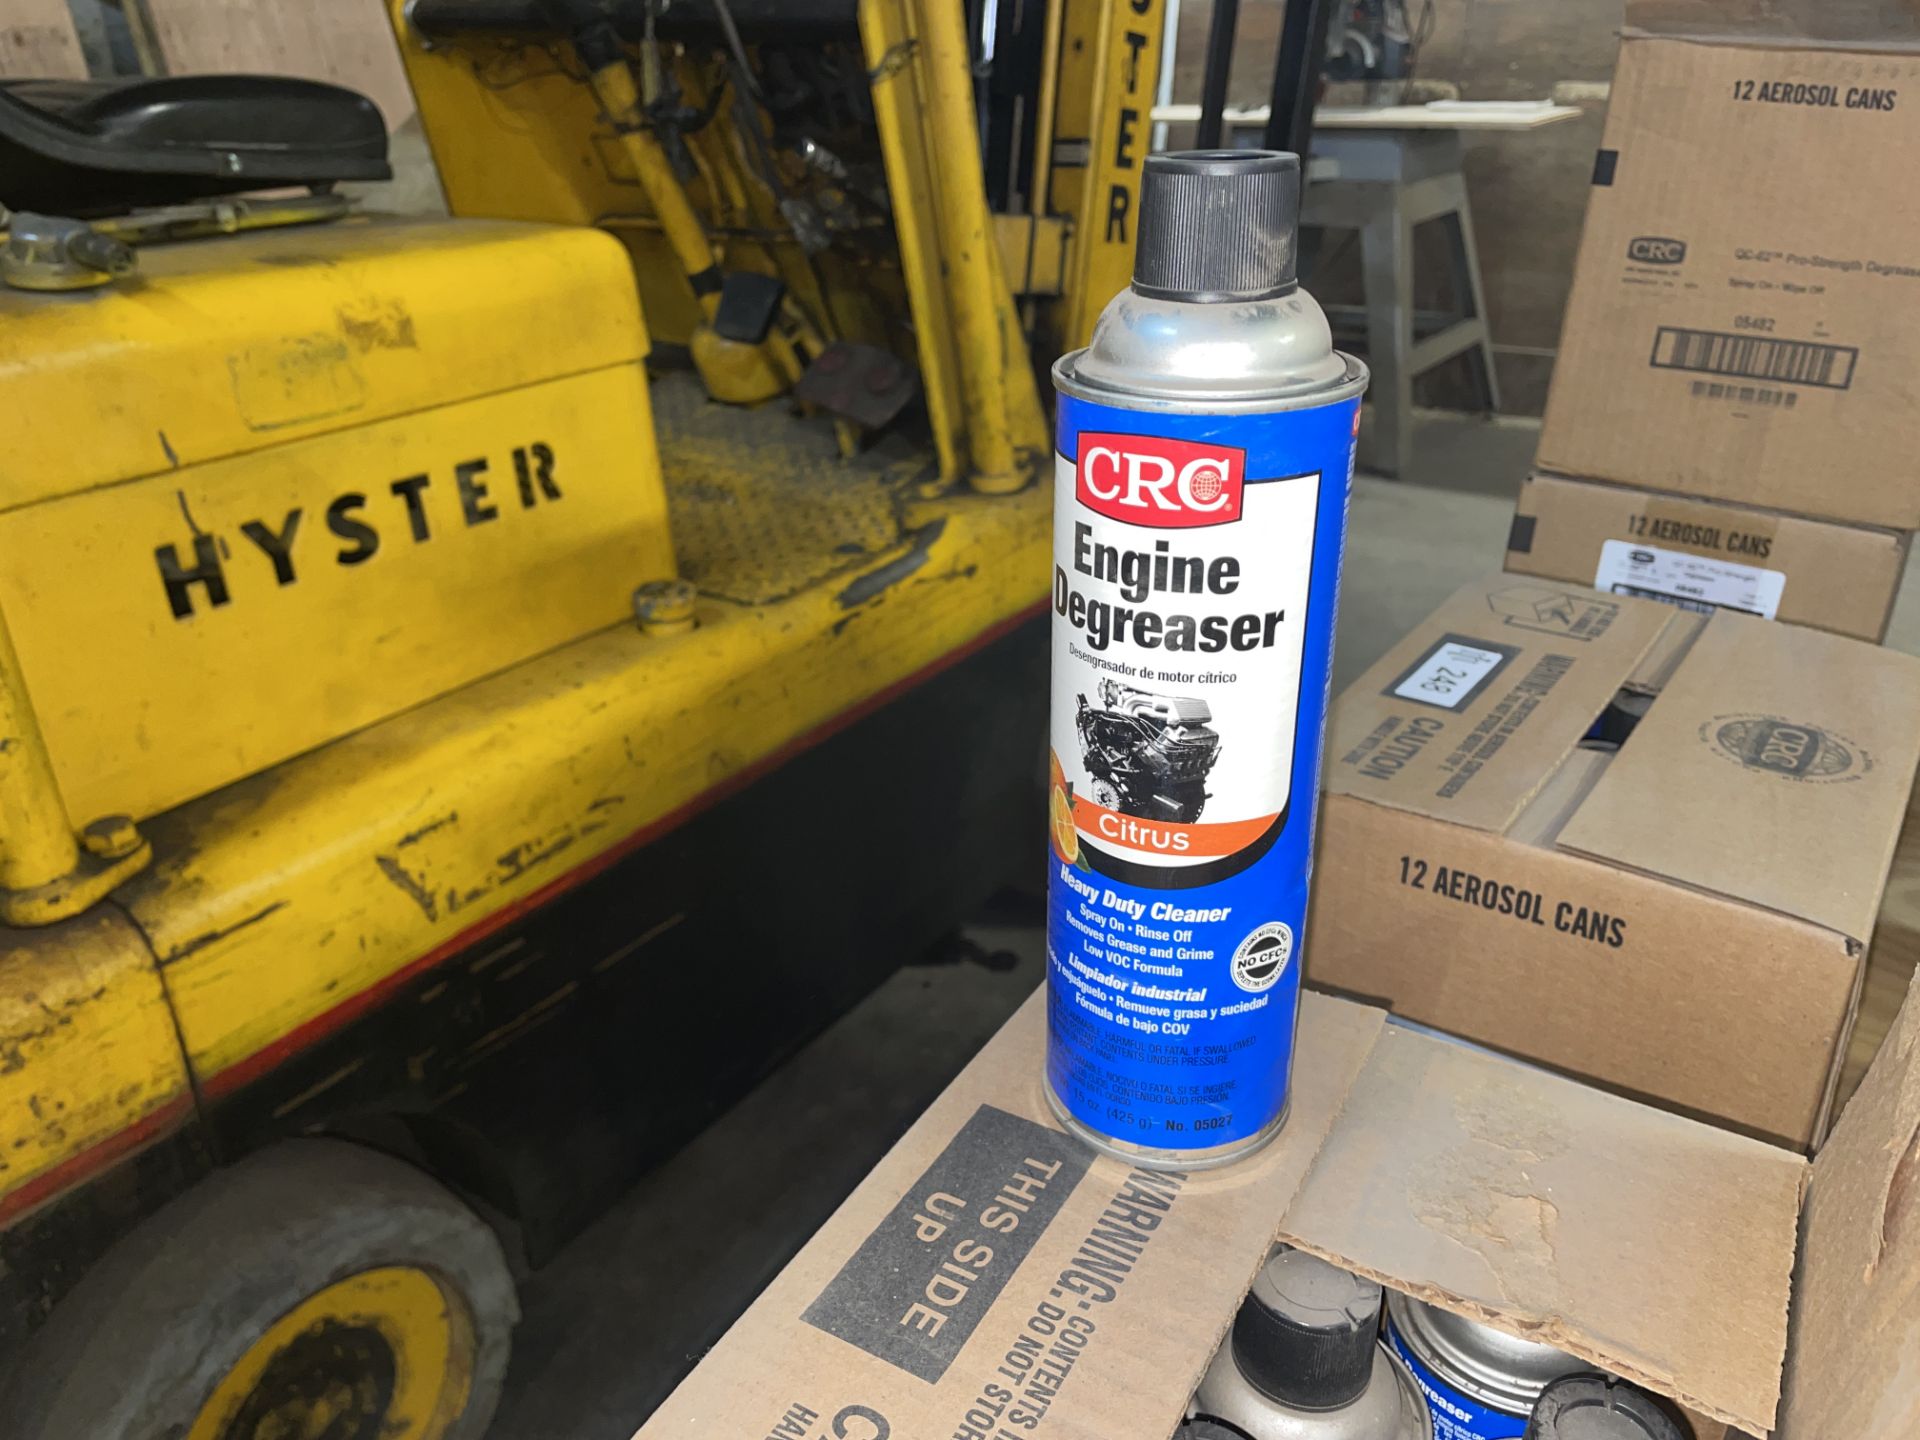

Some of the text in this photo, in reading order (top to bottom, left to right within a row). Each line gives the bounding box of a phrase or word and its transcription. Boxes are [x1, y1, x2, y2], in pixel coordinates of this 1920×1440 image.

[1733, 80, 1897, 111] 12 AEROSOL CANS
[1107, 0, 1150, 244] TER
[1632, 239, 1682, 261] CRC
[1084, 446, 1229, 512] CRC
[154, 441, 562, 621] HYSTER
[1628, 515, 1773, 559] 12 AEROSOL CANS
[1073, 520, 1240, 603] Engine
[1055, 564, 1285, 652] Degreaser
[1069, 643, 1237, 683] Desengrasador de motor cítrico
[1358, 716, 1444, 781] CAUTION
[1099, 813, 1190, 850] Citrus
[1060, 864, 1231, 923] Heavy Duty Cleaner
[1400, 856, 1626, 948] 12 AEROSOL CANS
[1066, 911, 1214, 960] Removes Grease and Grime
[1080, 903, 1192, 943] Spray On Rinse Off
[1068, 952, 1128, 991] Limpiador
[1132, 982, 1207, 1002] industrial
[1083, 939, 1183, 977] Low VOC Formula
[1237, 957, 1257, 969] NO
[1075, 992, 1190, 1036] Fórmula de bajo COV
[1116, 995, 1170, 1019] Remueve
[1174, 1005, 1207, 1021] grasa
[1210, 1006, 1217, 1020] y
[1220, 994, 1268, 1016] suciedad
[1101, 1040, 1145, 1063] CONTENTS
[1149, 1055, 1178, 1066] UNDER
[1105, 1032, 1257, 1056] HARMFUL OR FATAL IF SWALLOWED
[1111, 1081, 1162, 1104] CONTENIDO
[1165, 1095, 1188, 1106] BAJO
[1149, 1082, 1174, 1094] FATAL
[1177, 1085, 1187, 1095] SI
[1190, 1085, 1200, 1095] SE
[1107, 1107, 1134, 1125] (425
[1166, 1119, 1188, 1132] No.
[1194, 1113, 1233, 1131] 05027
[913, 1191, 967, 1243] UP
[1049, 1166, 1189, 1311] WARNING:
[899, 1156, 1063, 1339] THIS SIDE
[1027, 1301, 1066, 1336] DO
[997, 1334, 1045, 1387] NOT
[1007, 1315, 1096, 1430] CONTENTS
